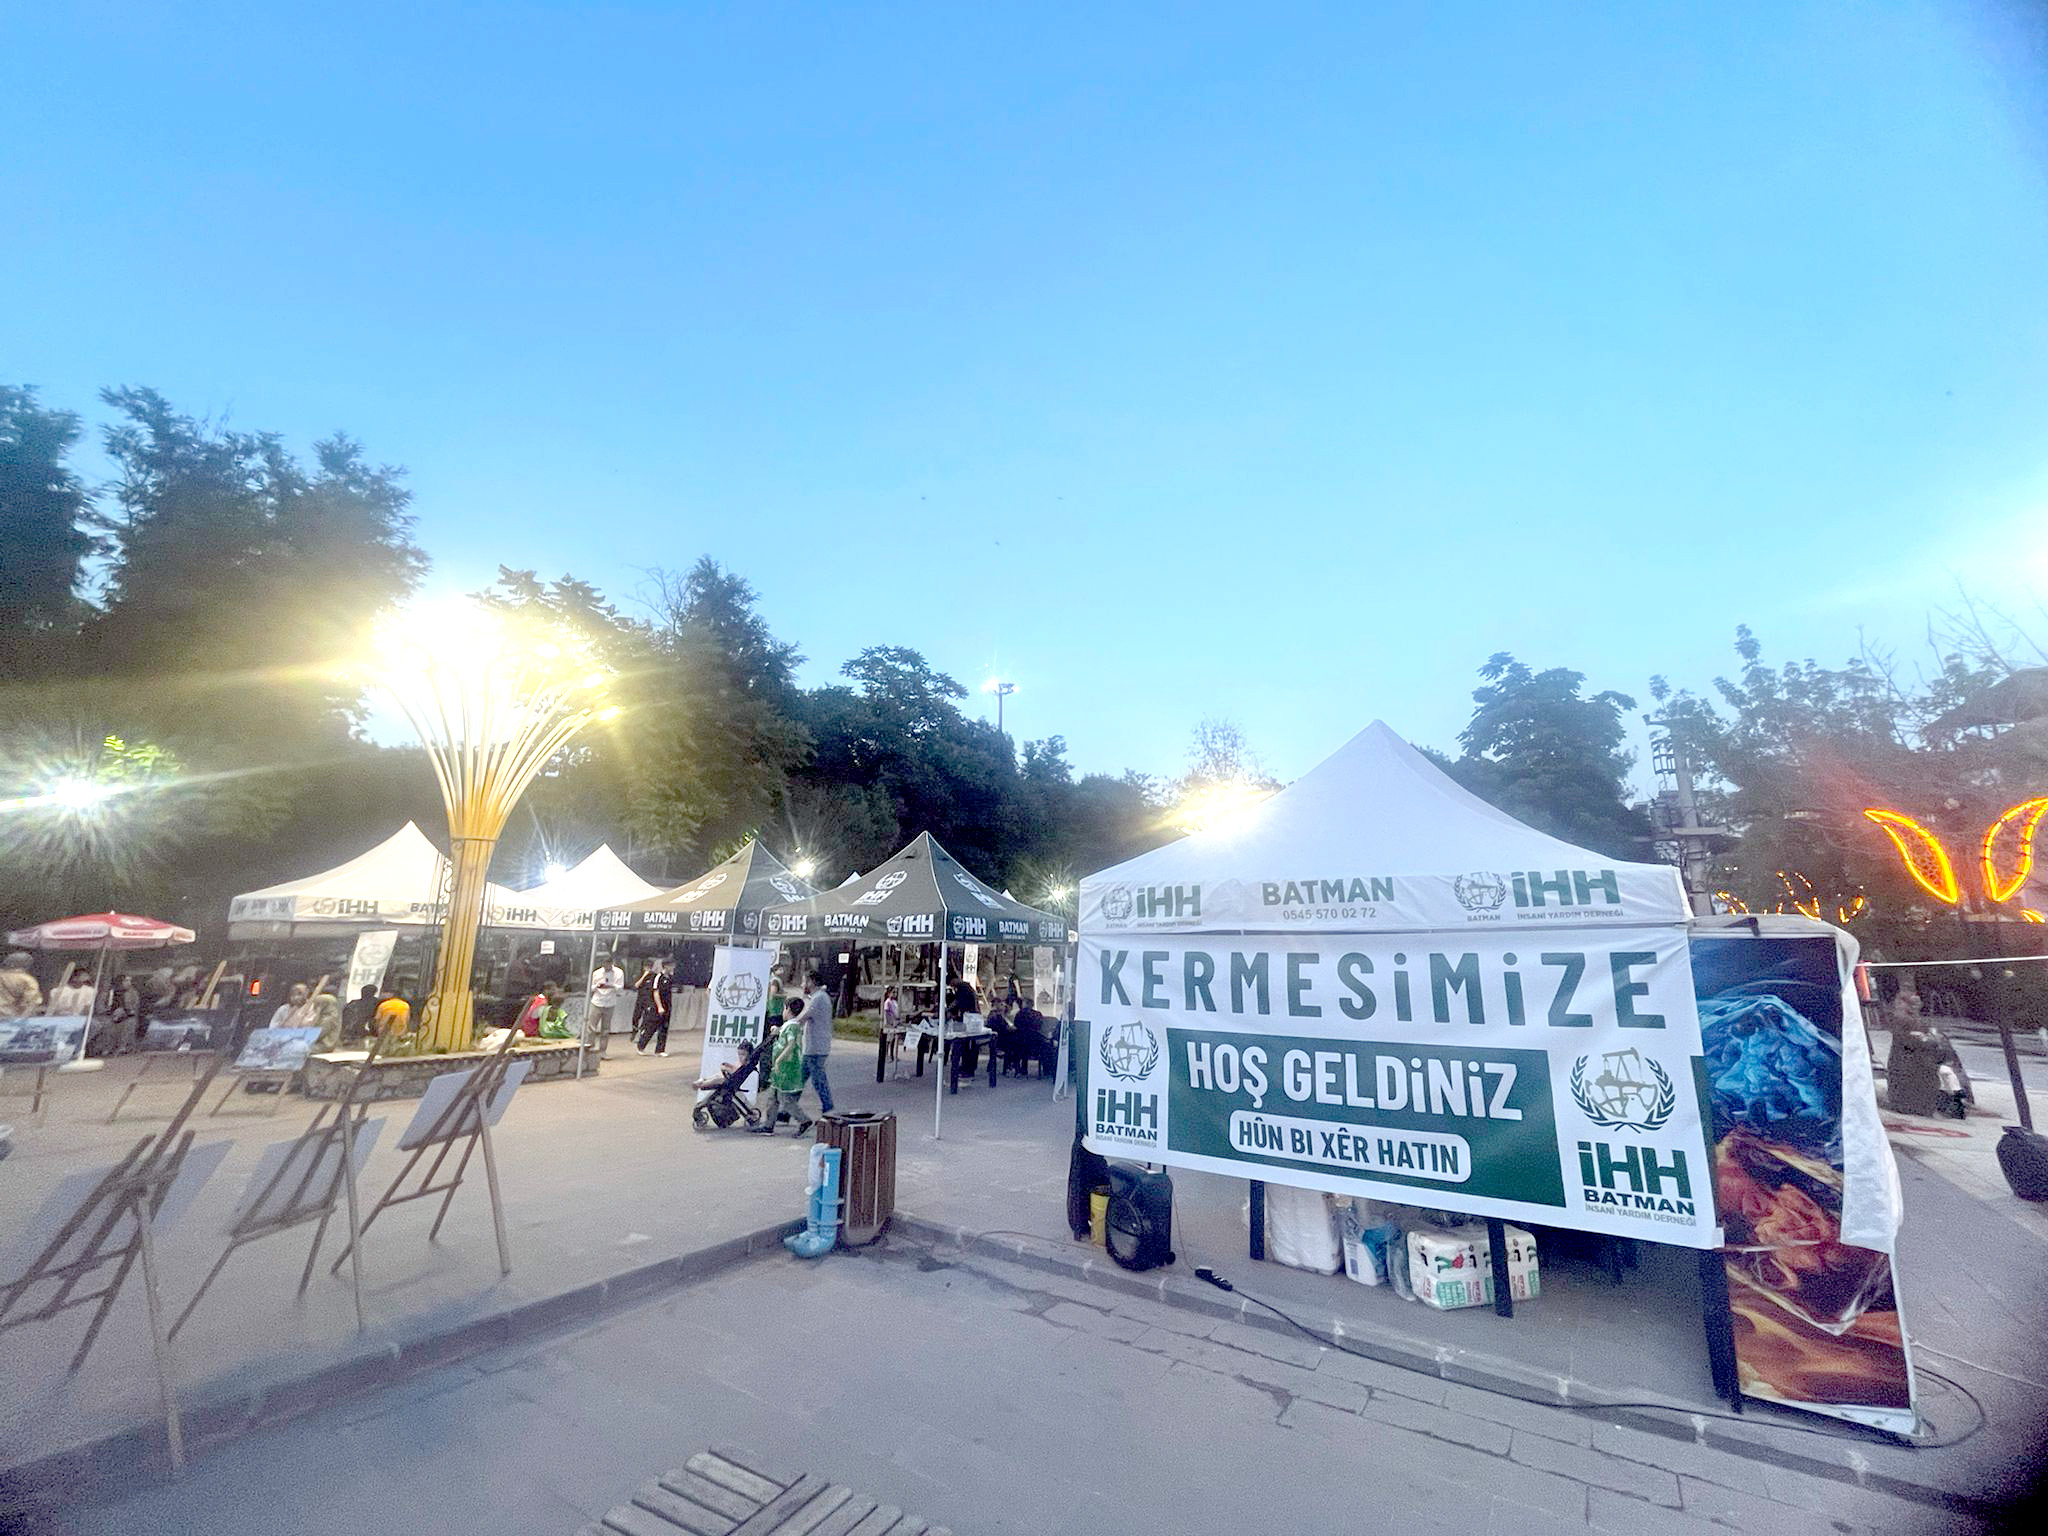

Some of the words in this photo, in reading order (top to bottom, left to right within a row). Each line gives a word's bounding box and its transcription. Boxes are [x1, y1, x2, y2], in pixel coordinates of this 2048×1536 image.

[1262, 877, 1394, 906] BATMAN
[643, 912, 678, 924] BATMAN
[824, 913, 870, 927] BATMAN
[1283, 910, 1312, 920] 0545
[1316, 909, 1337, 919] 570
[1341, 908, 1357, 918] 02
[1361, 907, 1376, 918] 72
[998, 920, 1029, 935] BATMAN
[1187, 1041, 1268, 1109] HOŞ
[1096, 1123, 1157, 1141] BATMAN
[1239, 1117, 1284, 1151] HÛN
[1290, 1128, 1313, 1156] BI
[1320, 1127, 1369, 1163] XÊR
[1378, 1139, 1459, 1175] HATIN
[1584, 1189, 1696, 1216] BATMAN
